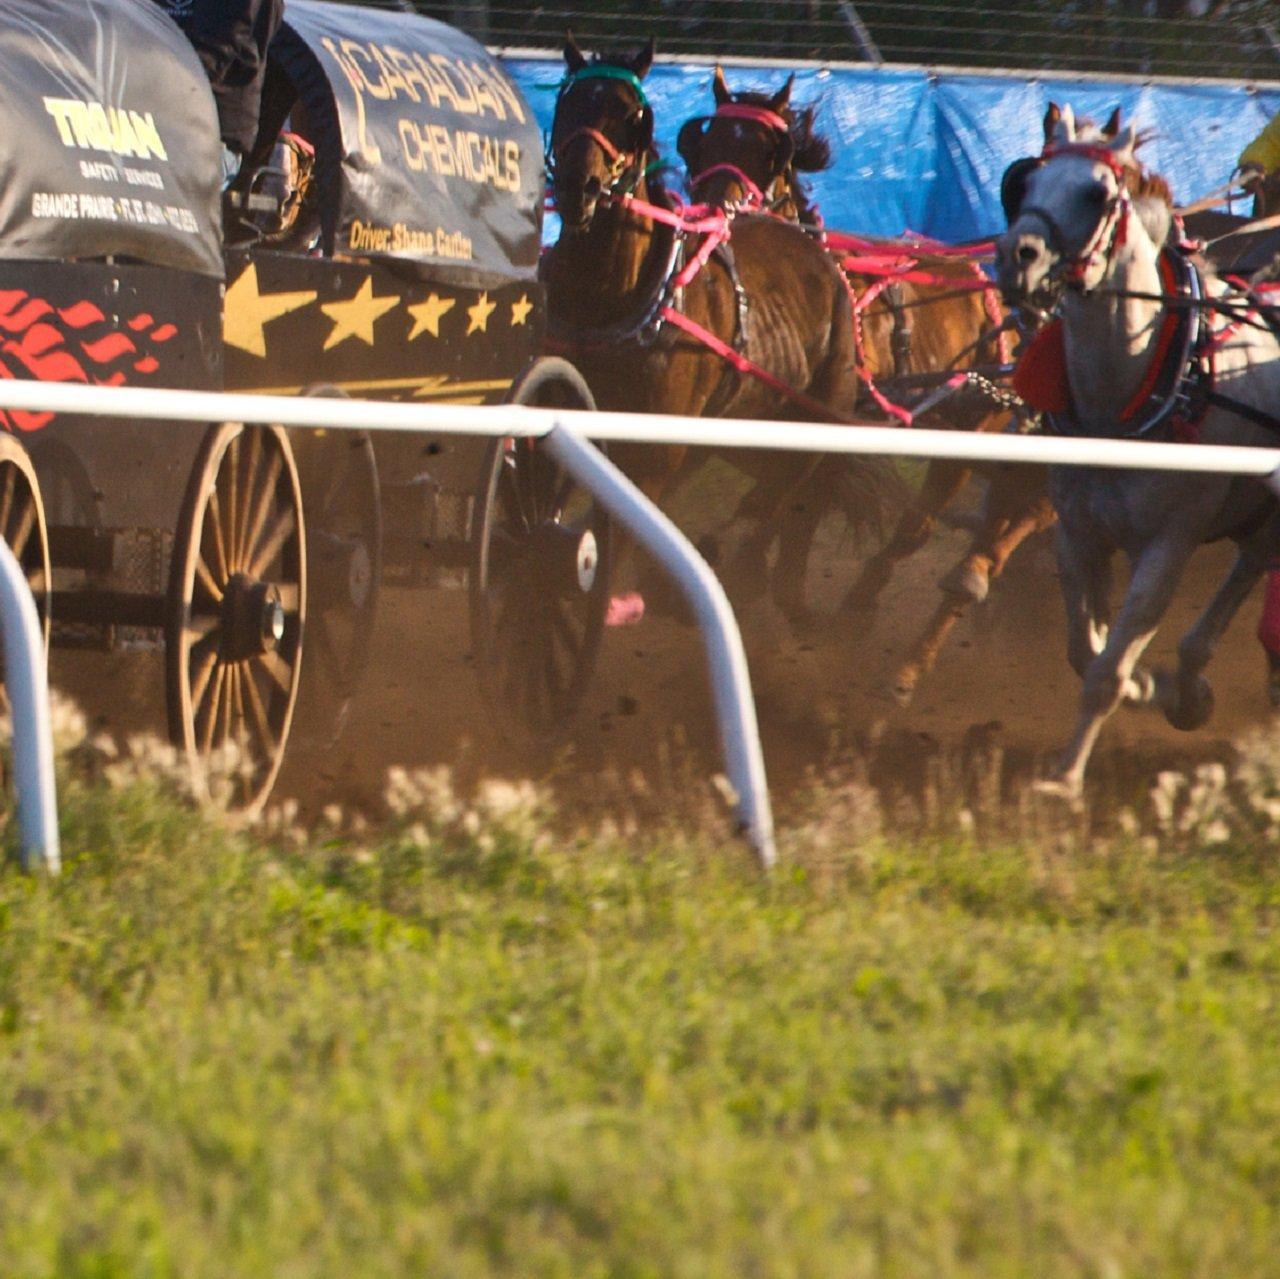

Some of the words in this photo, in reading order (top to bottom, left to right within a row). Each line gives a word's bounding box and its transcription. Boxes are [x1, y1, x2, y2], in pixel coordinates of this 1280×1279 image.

[42, 98, 168, 161] TROJAN
[397, 118, 522, 193] CHEMICALS
[33, 192, 78, 219] GRANDE
